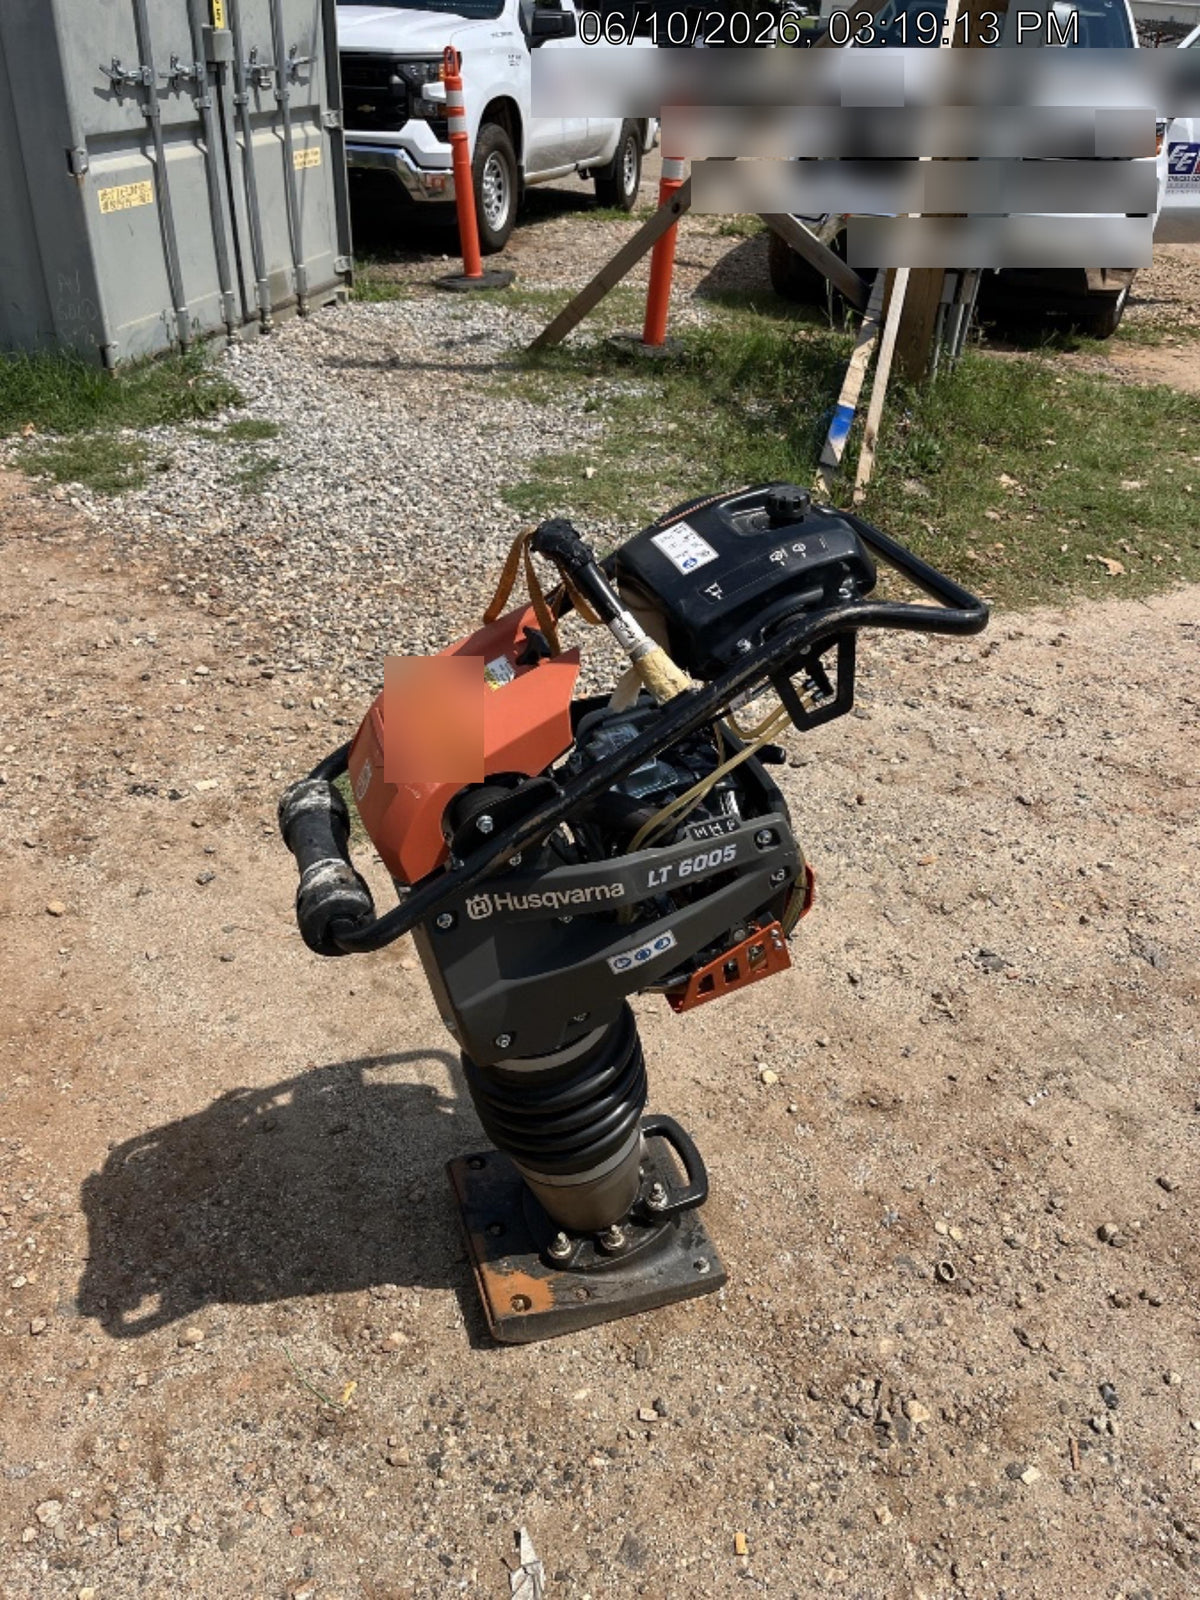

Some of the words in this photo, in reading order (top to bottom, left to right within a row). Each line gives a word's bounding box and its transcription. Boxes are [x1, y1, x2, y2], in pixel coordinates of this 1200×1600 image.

[647, 865, 673, 888] LT
[678, 843, 737, 877] 6005
[494, 883, 625, 911] Husqvarna
